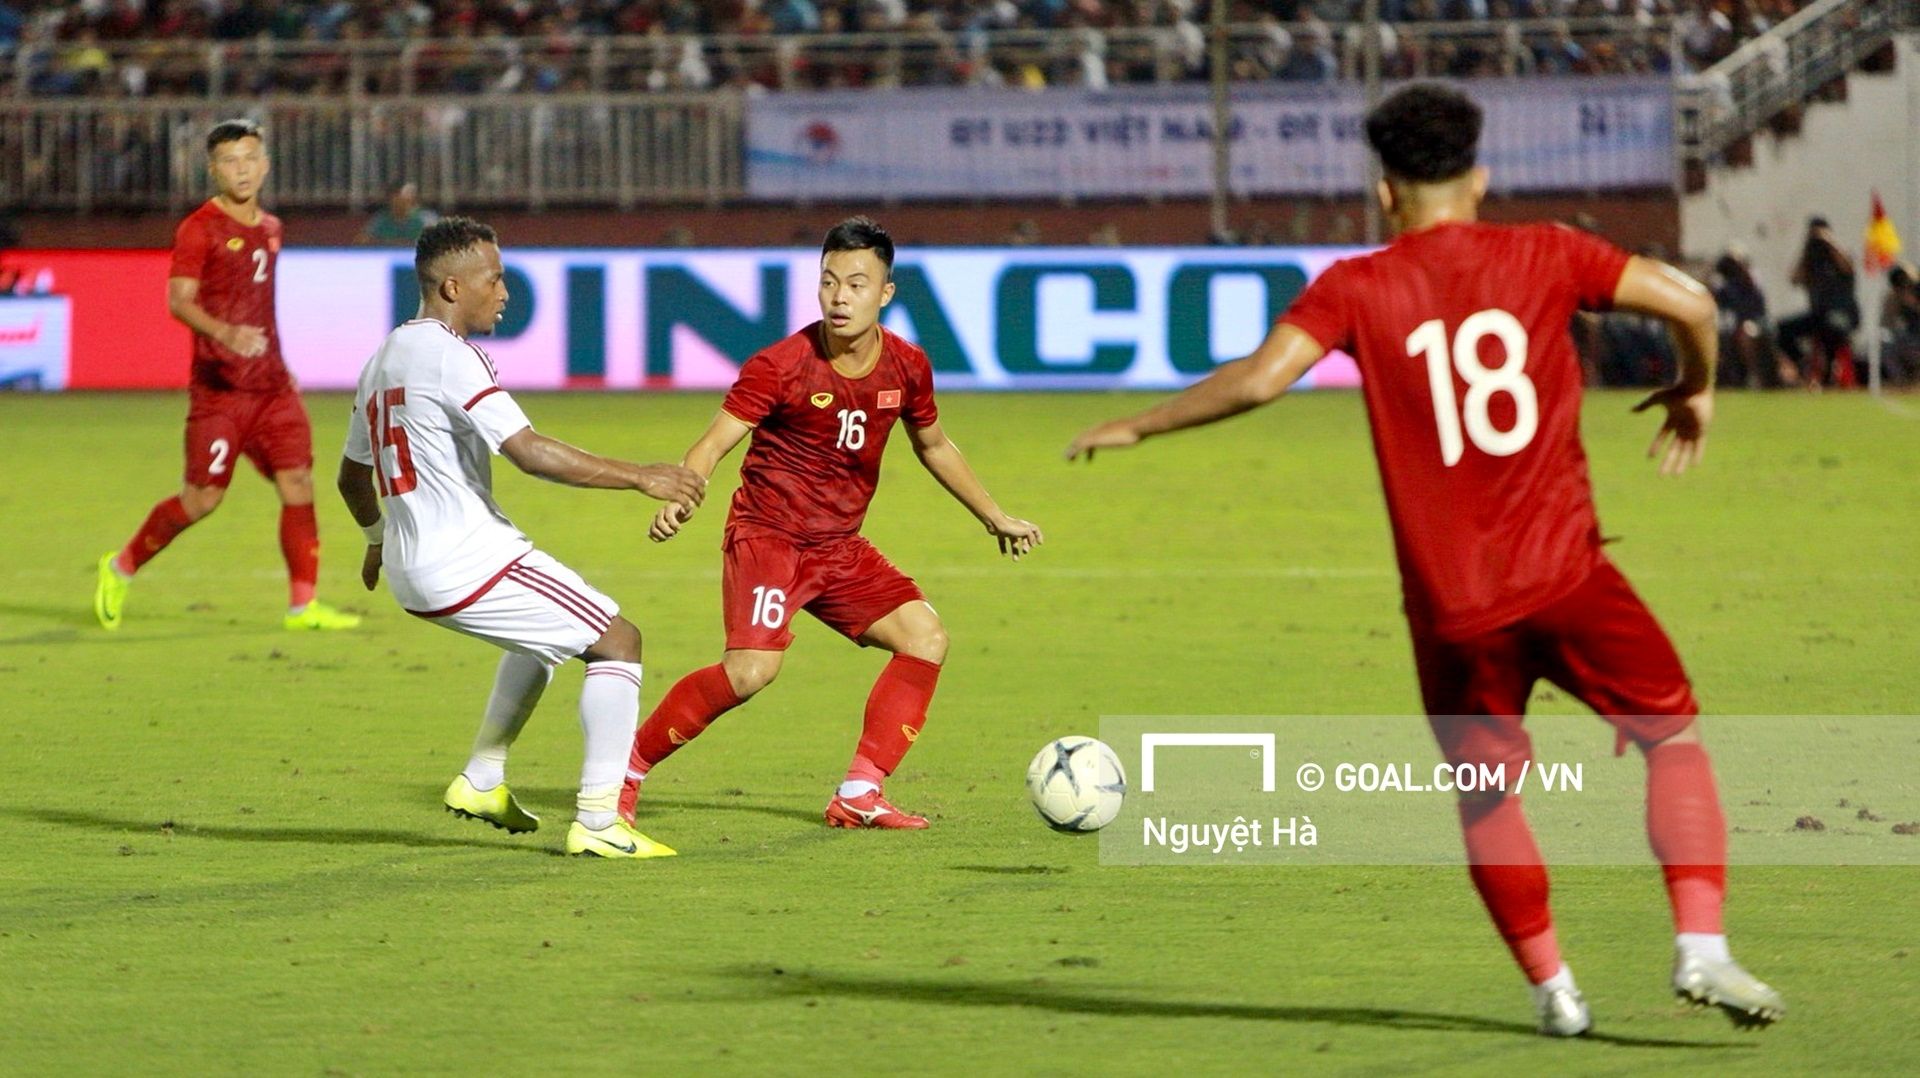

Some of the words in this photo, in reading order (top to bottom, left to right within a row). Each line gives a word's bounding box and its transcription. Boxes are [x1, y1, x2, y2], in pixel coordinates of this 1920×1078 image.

[252, 249, 268, 283] 2
[1405, 308, 1539, 467] 18
[366, 386, 418, 498] 15
[836, 409, 867, 450] 16
[207, 439, 229, 475] 2
[751, 585, 786, 629] 16
